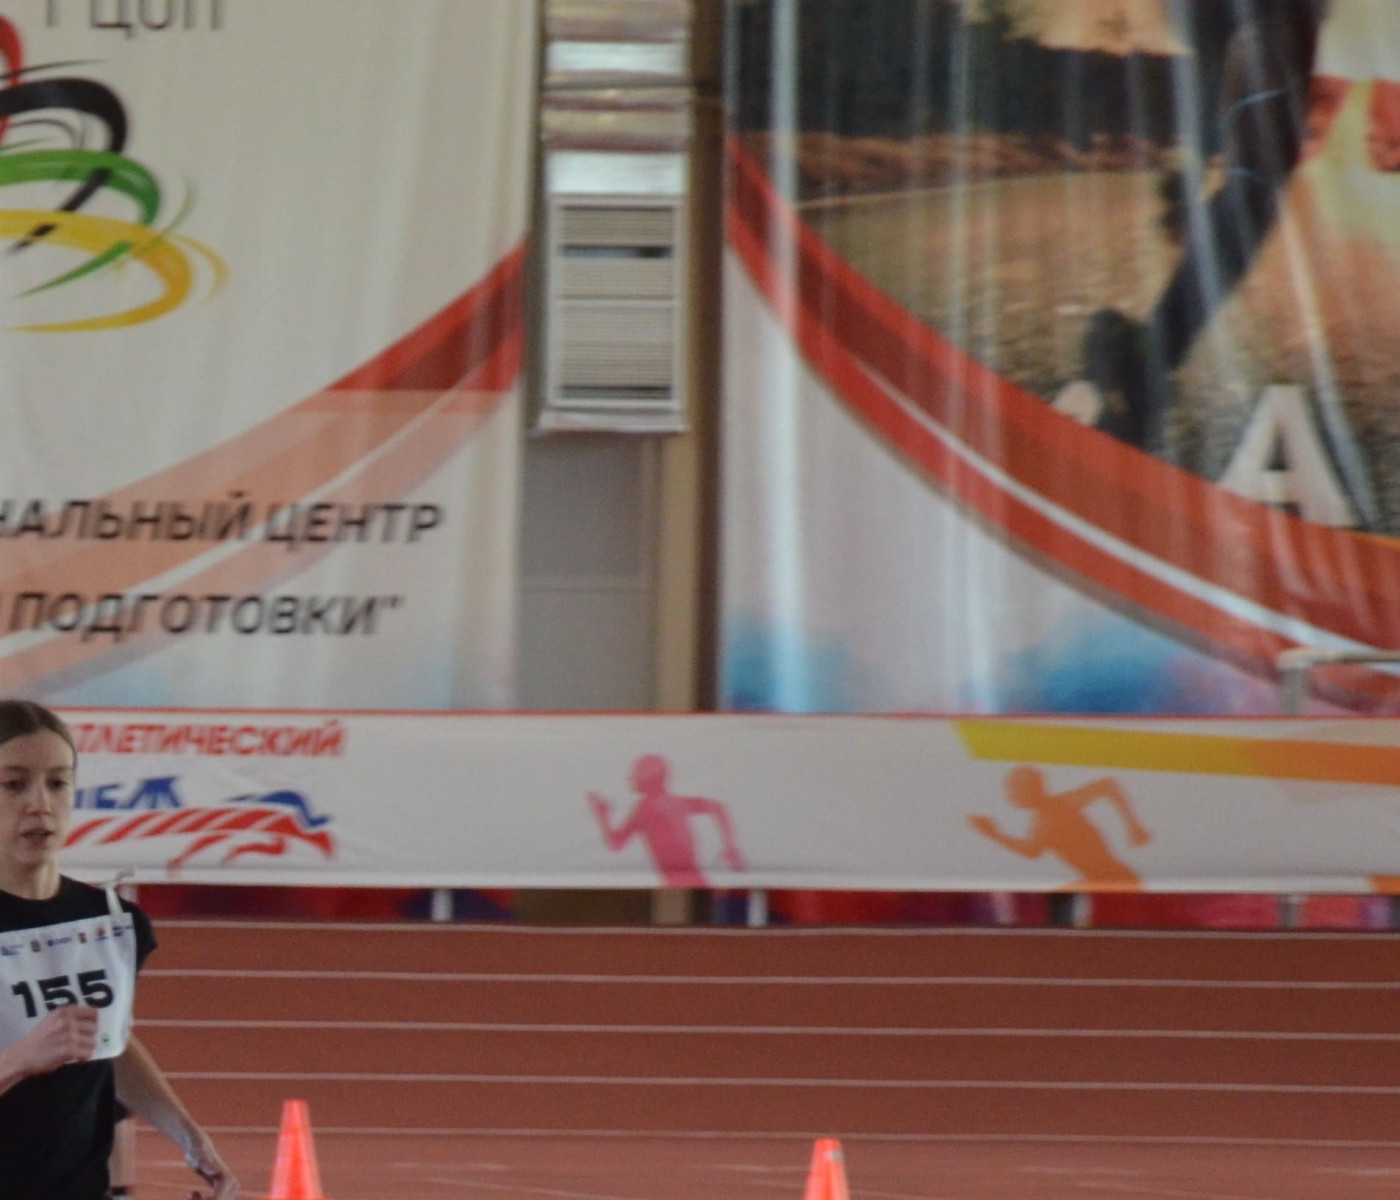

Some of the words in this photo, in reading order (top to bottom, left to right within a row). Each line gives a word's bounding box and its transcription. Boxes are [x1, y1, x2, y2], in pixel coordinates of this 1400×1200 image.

[264, 501, 446, 552] ЦЕНТР
[8, 592, 406, 642] ПОДГОТОВКИ"
[12, 969, 114, 1018] 155
